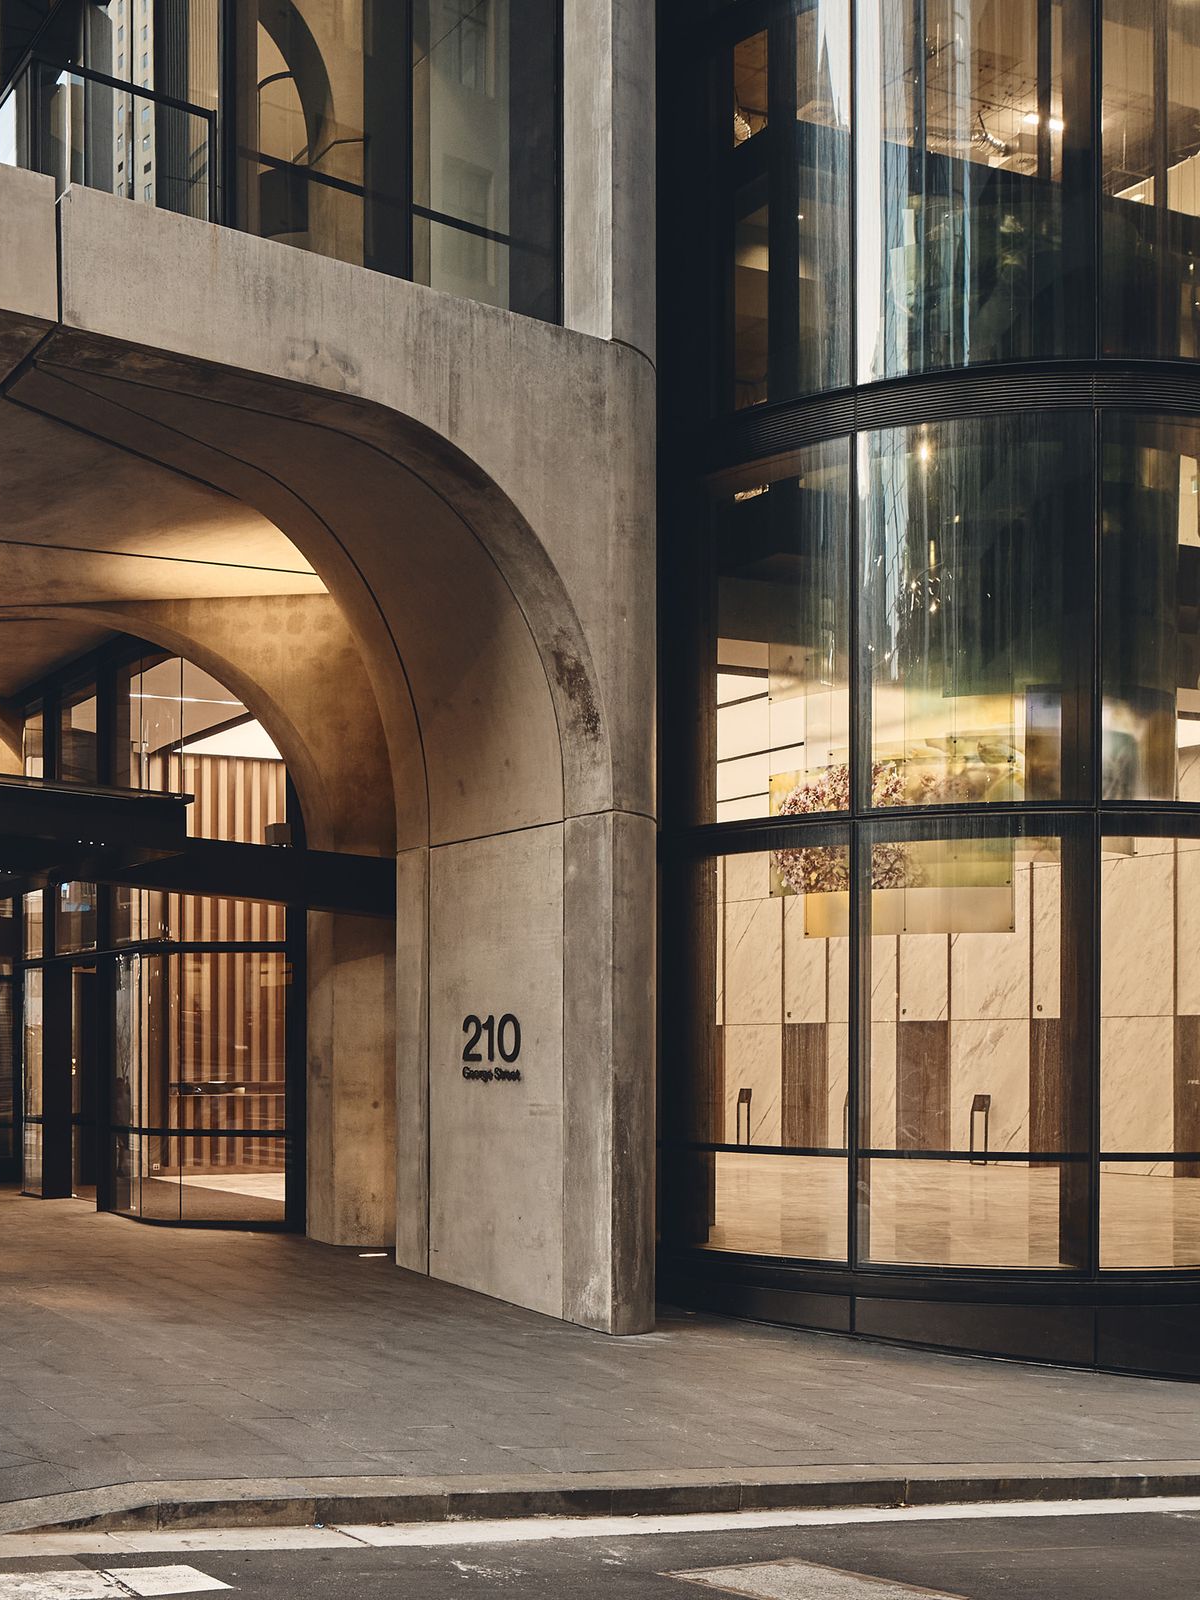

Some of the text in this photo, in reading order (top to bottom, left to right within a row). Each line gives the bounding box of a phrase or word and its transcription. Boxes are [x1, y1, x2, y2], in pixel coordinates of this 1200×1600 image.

[462, 1013, 521, 1063] 210
[462, 1066, 521, 1083] George Street
